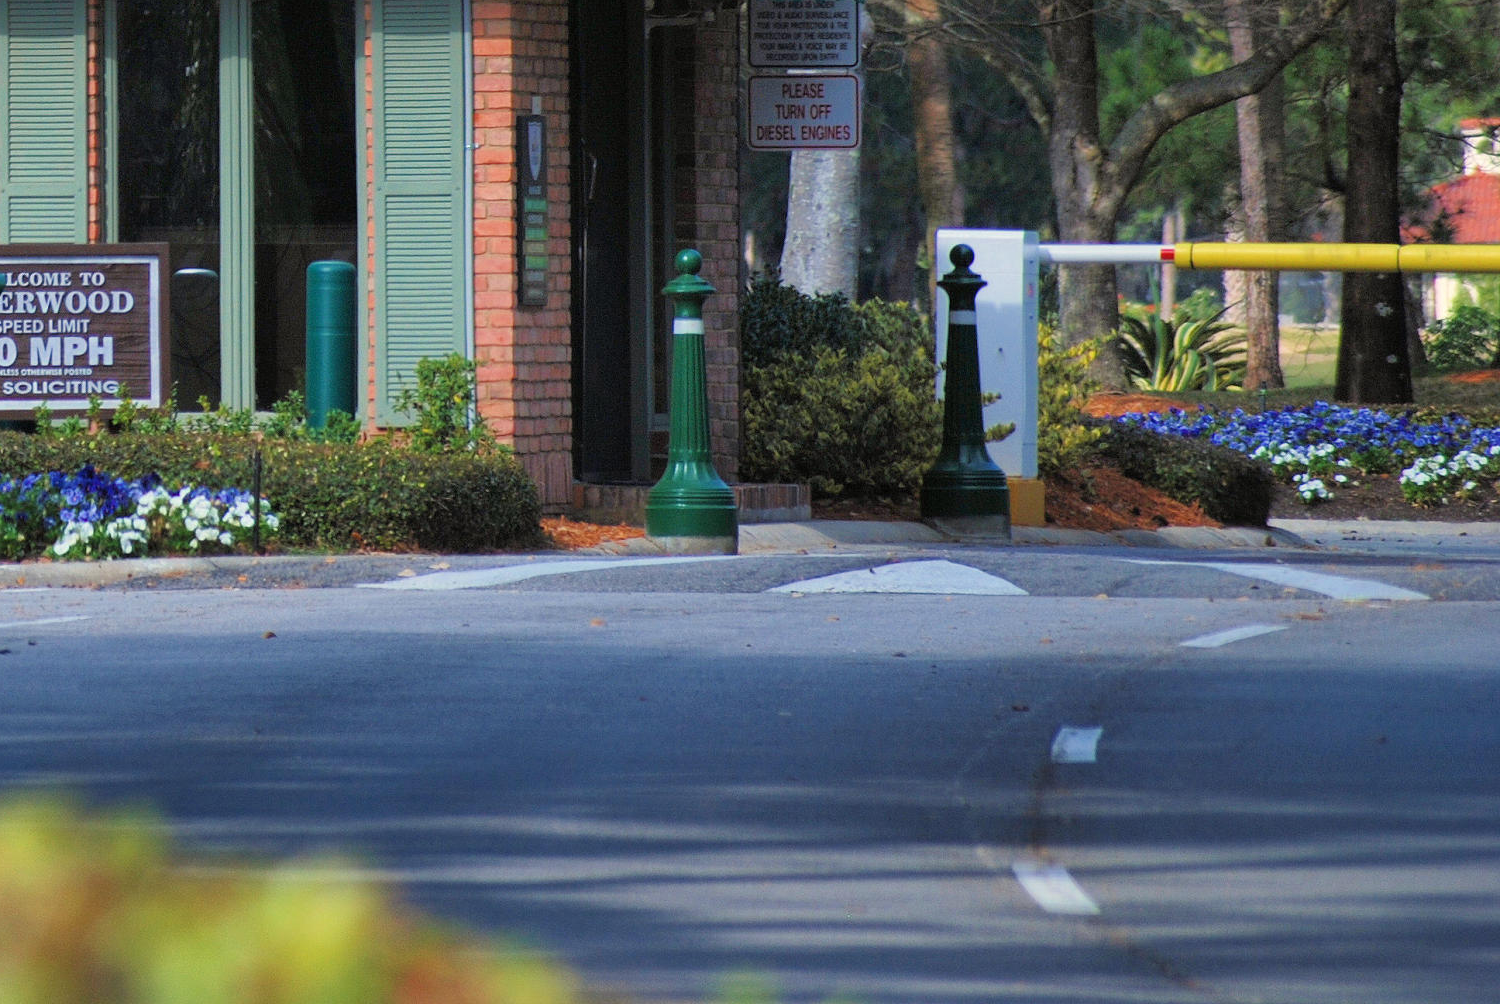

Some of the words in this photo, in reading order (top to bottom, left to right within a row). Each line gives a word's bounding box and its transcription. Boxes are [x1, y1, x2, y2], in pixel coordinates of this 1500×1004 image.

[781, 83, 825, 99] PLEASE
[775, 104, 805, 120] TURN
[810, 104, 832, 120] OFF
[756, 126, 796, 141] DIESEL
[801, 125, 851, 141] ENGINES
[5, 271, 72, 288] LCOME
[80, 271, 106, 287] TO
[48, 319, 90, 334] LIMIT
[29, 336, 114, 367] MPH
[20, 368, 62, 376] OTHERWISE
[63, 367, 93, 376] POSTED
[2, 380, 120, 395] SOLICITING
